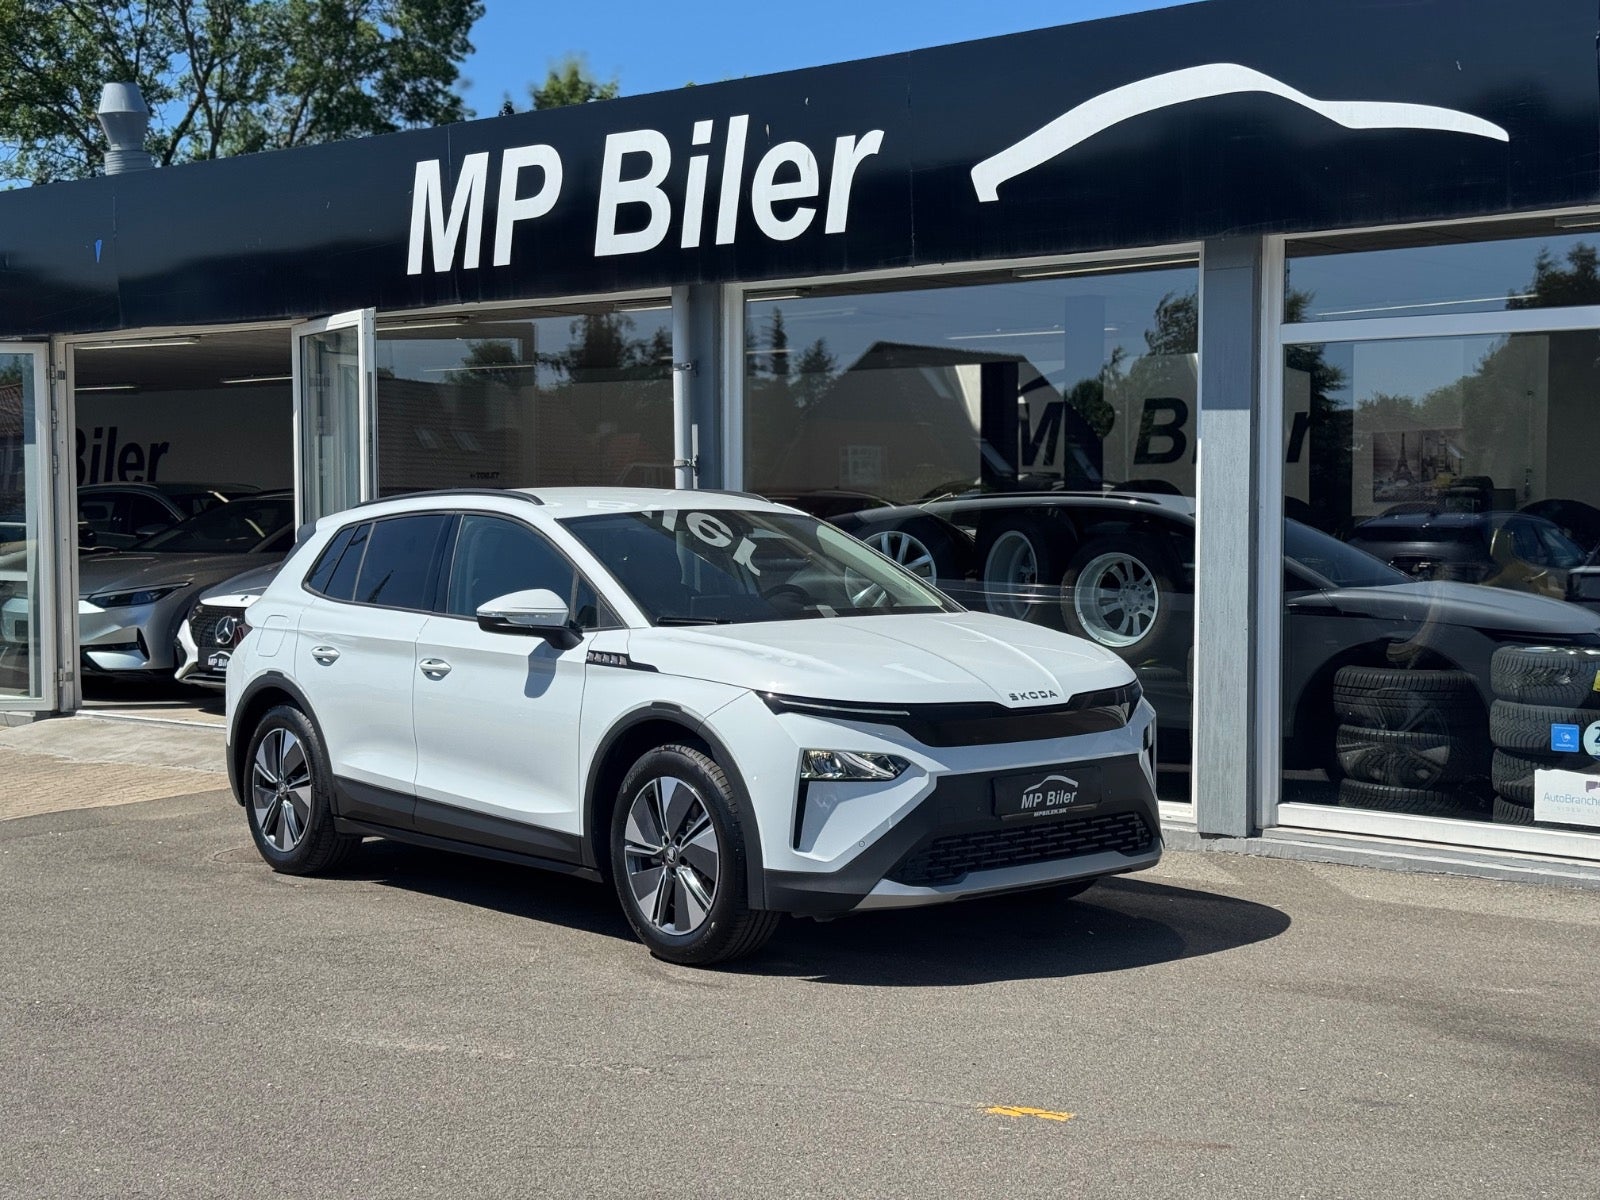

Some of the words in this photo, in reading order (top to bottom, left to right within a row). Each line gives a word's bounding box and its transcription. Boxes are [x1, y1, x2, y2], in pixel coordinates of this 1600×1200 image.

[407, 143, 563, 275] MP
[594, 114, 885, 257] Biler
[1021, 792, 1043, 809] MP
[1046, 789, 1078, 806] Biler
